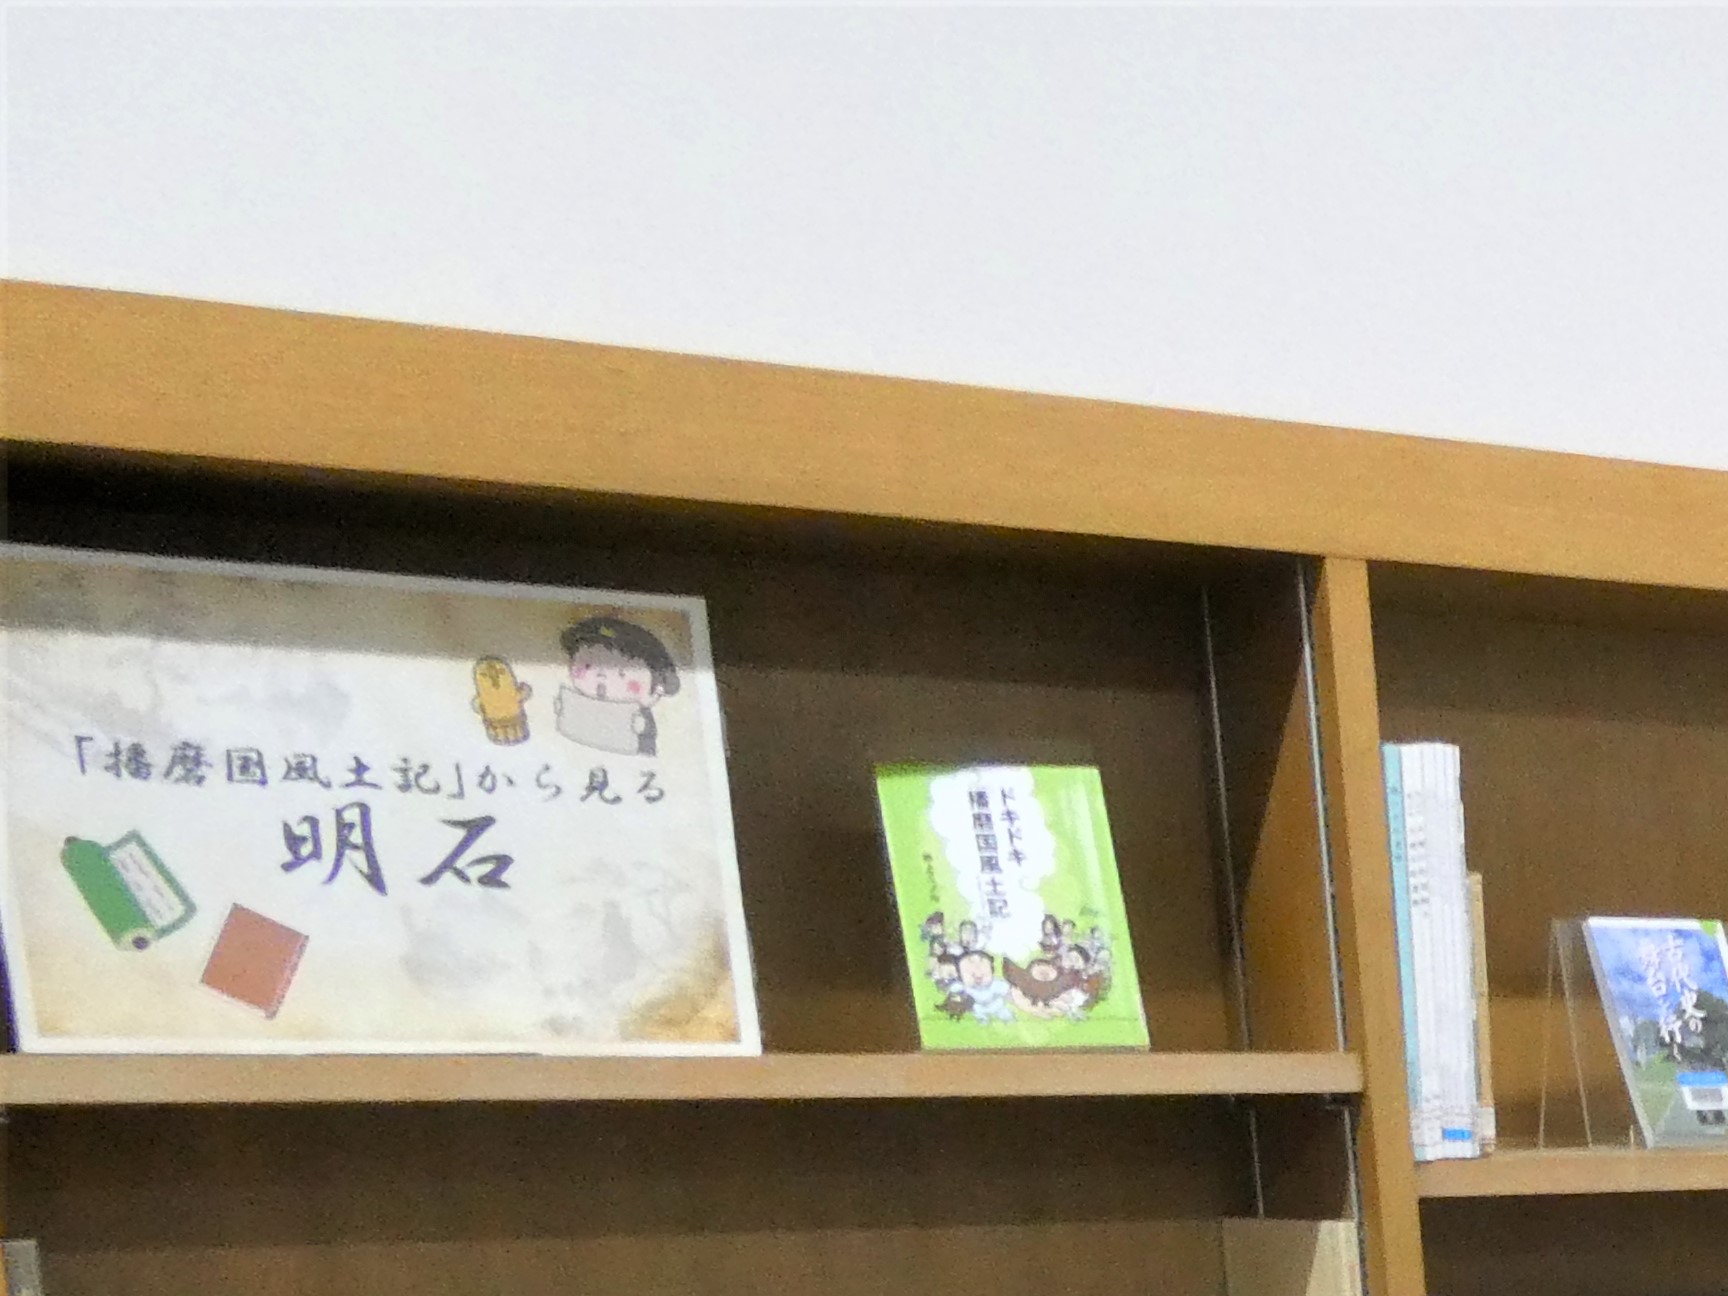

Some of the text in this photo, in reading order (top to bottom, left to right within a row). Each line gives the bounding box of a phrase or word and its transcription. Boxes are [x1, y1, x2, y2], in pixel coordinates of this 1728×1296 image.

[73, 734, 666, 806] 「播磨国風土記」から見る
[280, 802, 516, 896] 明石
